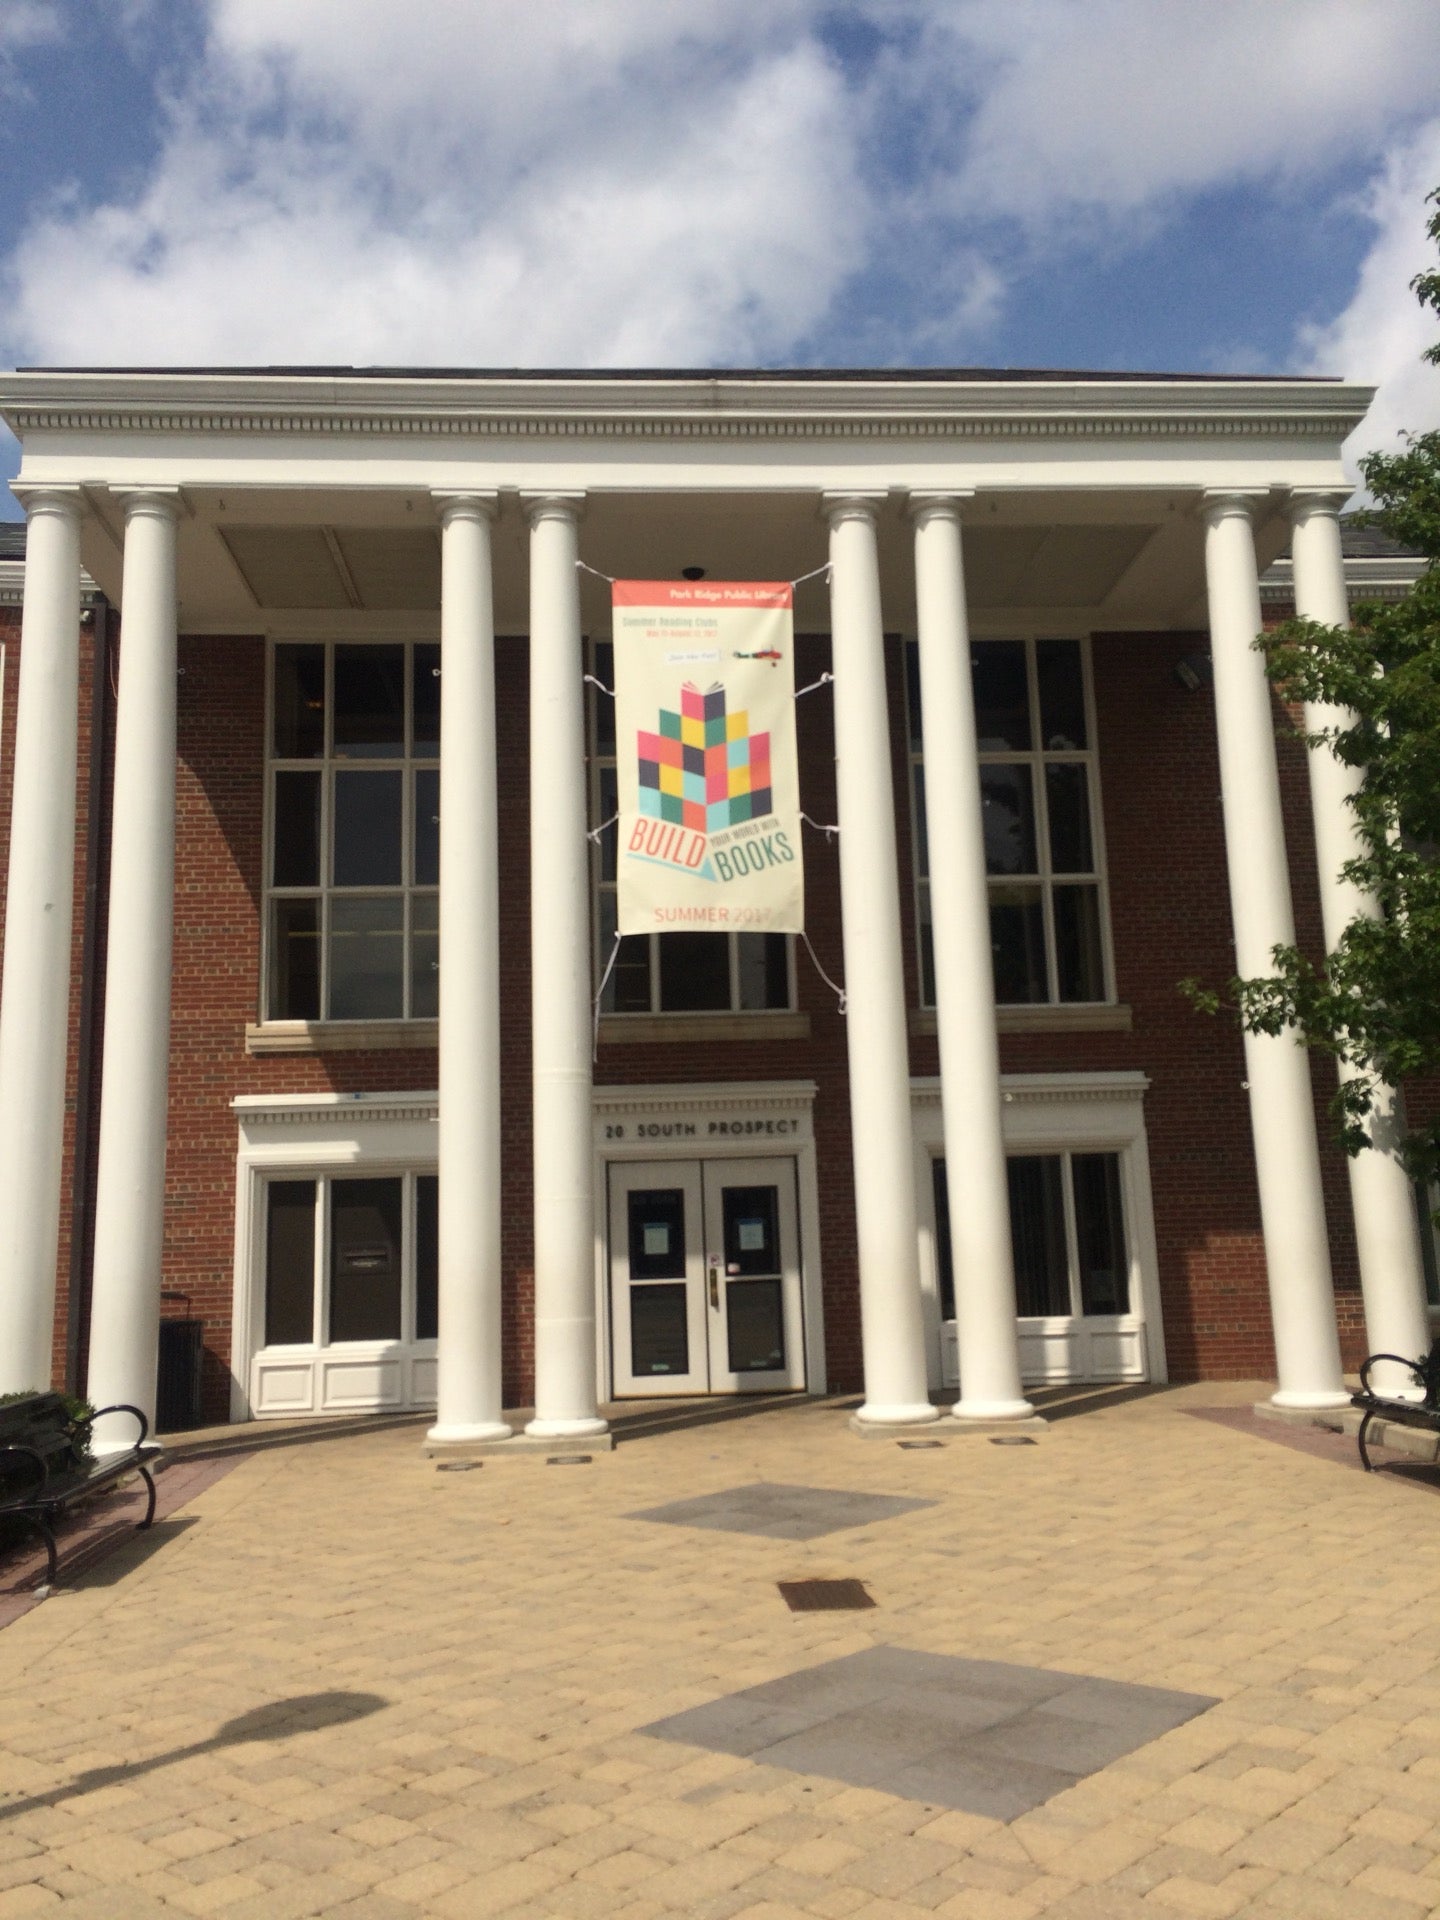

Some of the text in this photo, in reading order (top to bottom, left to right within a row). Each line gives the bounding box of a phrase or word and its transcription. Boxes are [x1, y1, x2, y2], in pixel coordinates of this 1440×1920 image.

[669, 588, 692, 600] Park
[694, 588, 722, 601] Ridge
[724, 589, 752, 600] Public
[622, 617, 656, 628] Summer
[659, 617, 692, 628] Reading
[628, 818, 706, 868] BUILD
[709, 833, 731, 847] YOUR
[733, 824, 760, 841] WORLD
[714, 831, 795, 882] BOOKS
[654, 906, 729, 923] SUMMER
[605, 1119, 799, 1139] 20 SOUTH PROSPECT
